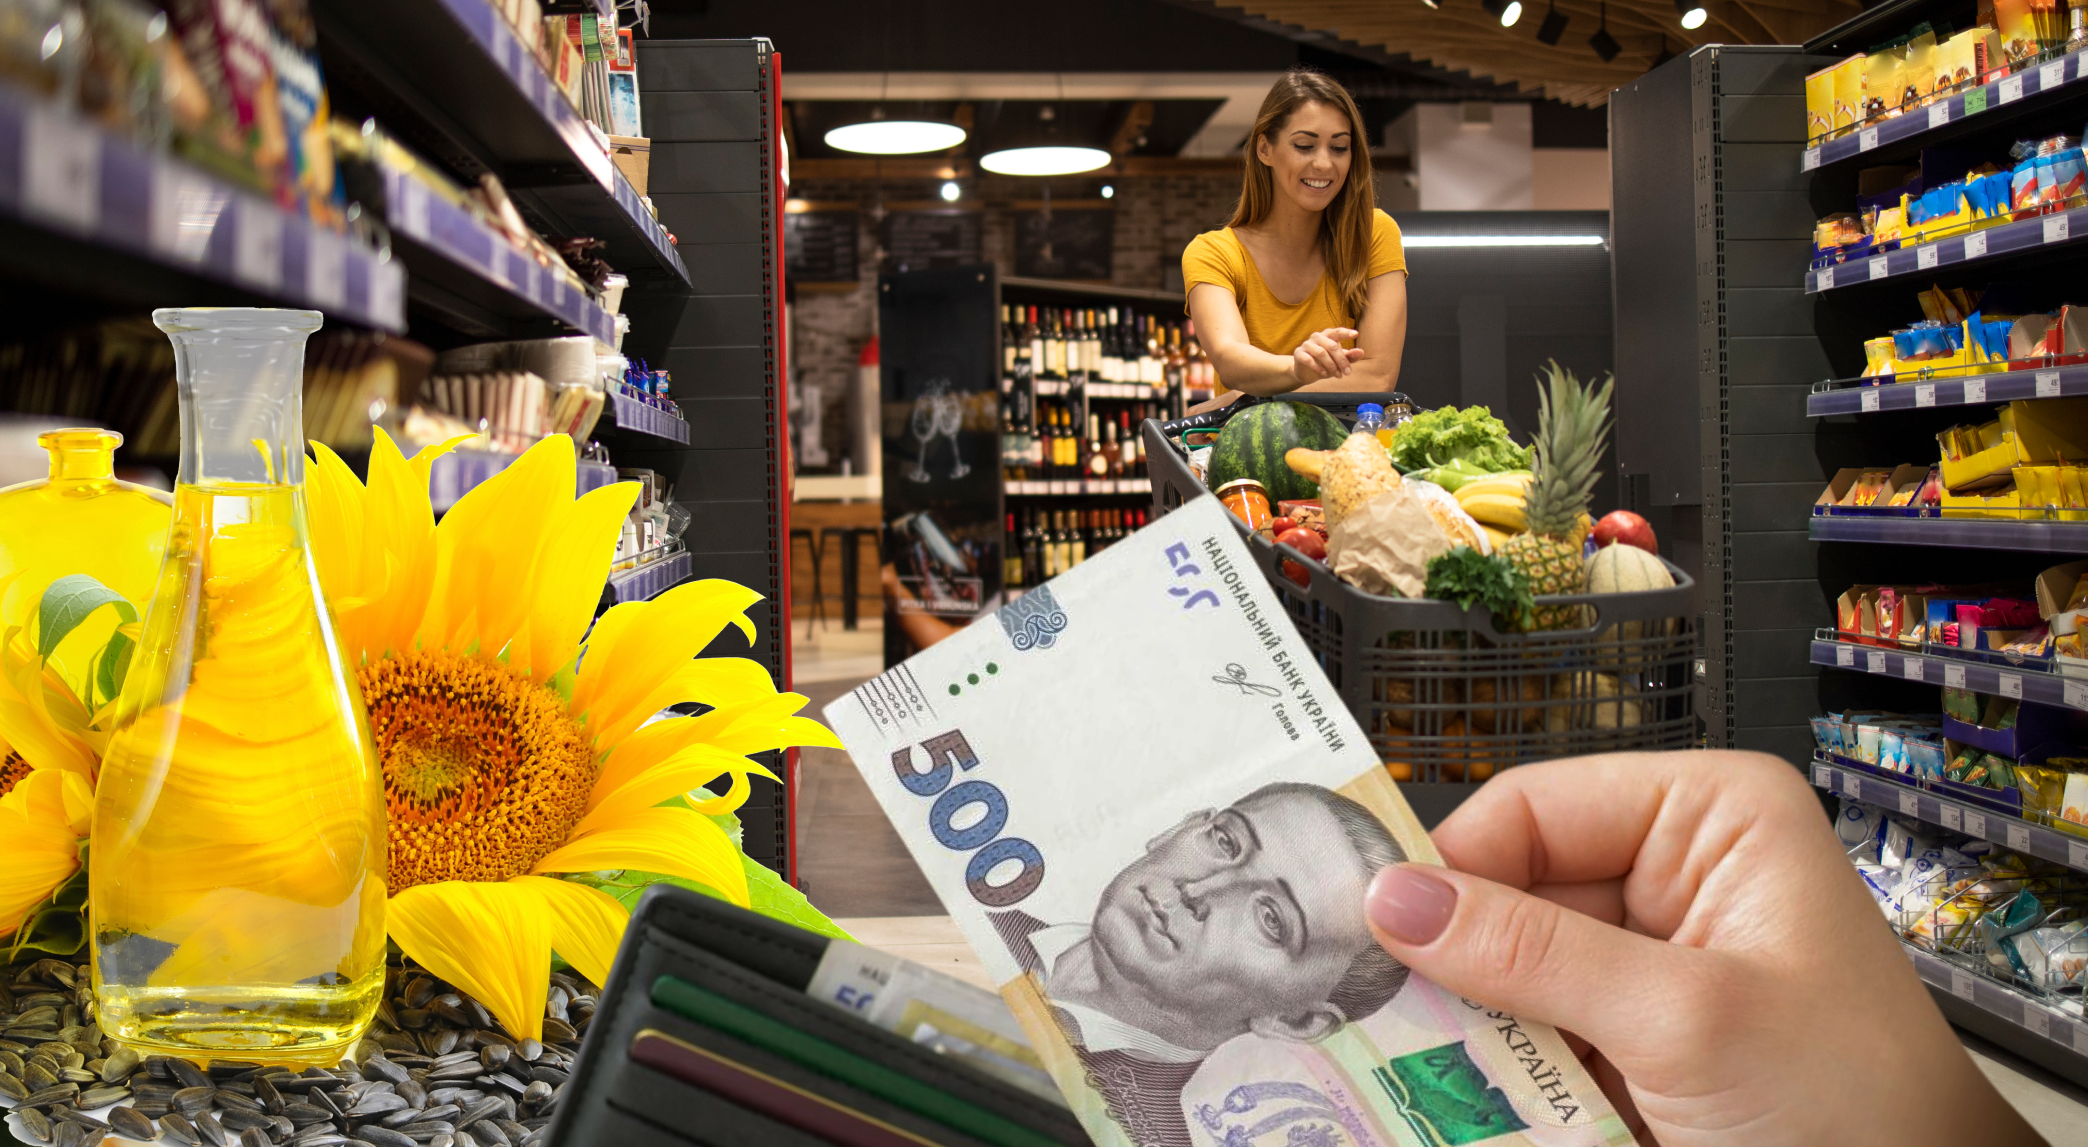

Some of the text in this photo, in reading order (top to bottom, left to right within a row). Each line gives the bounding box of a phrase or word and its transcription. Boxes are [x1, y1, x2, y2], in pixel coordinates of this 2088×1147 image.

[1202, 536, 1283, 651] НАЦІОНАЛЬНИЙ
[1272, 650, 1305, 692] БАНК
[1298, 689, 1346, 753] УКРАЇНИ
[891, 728, 1046, 908] 500
